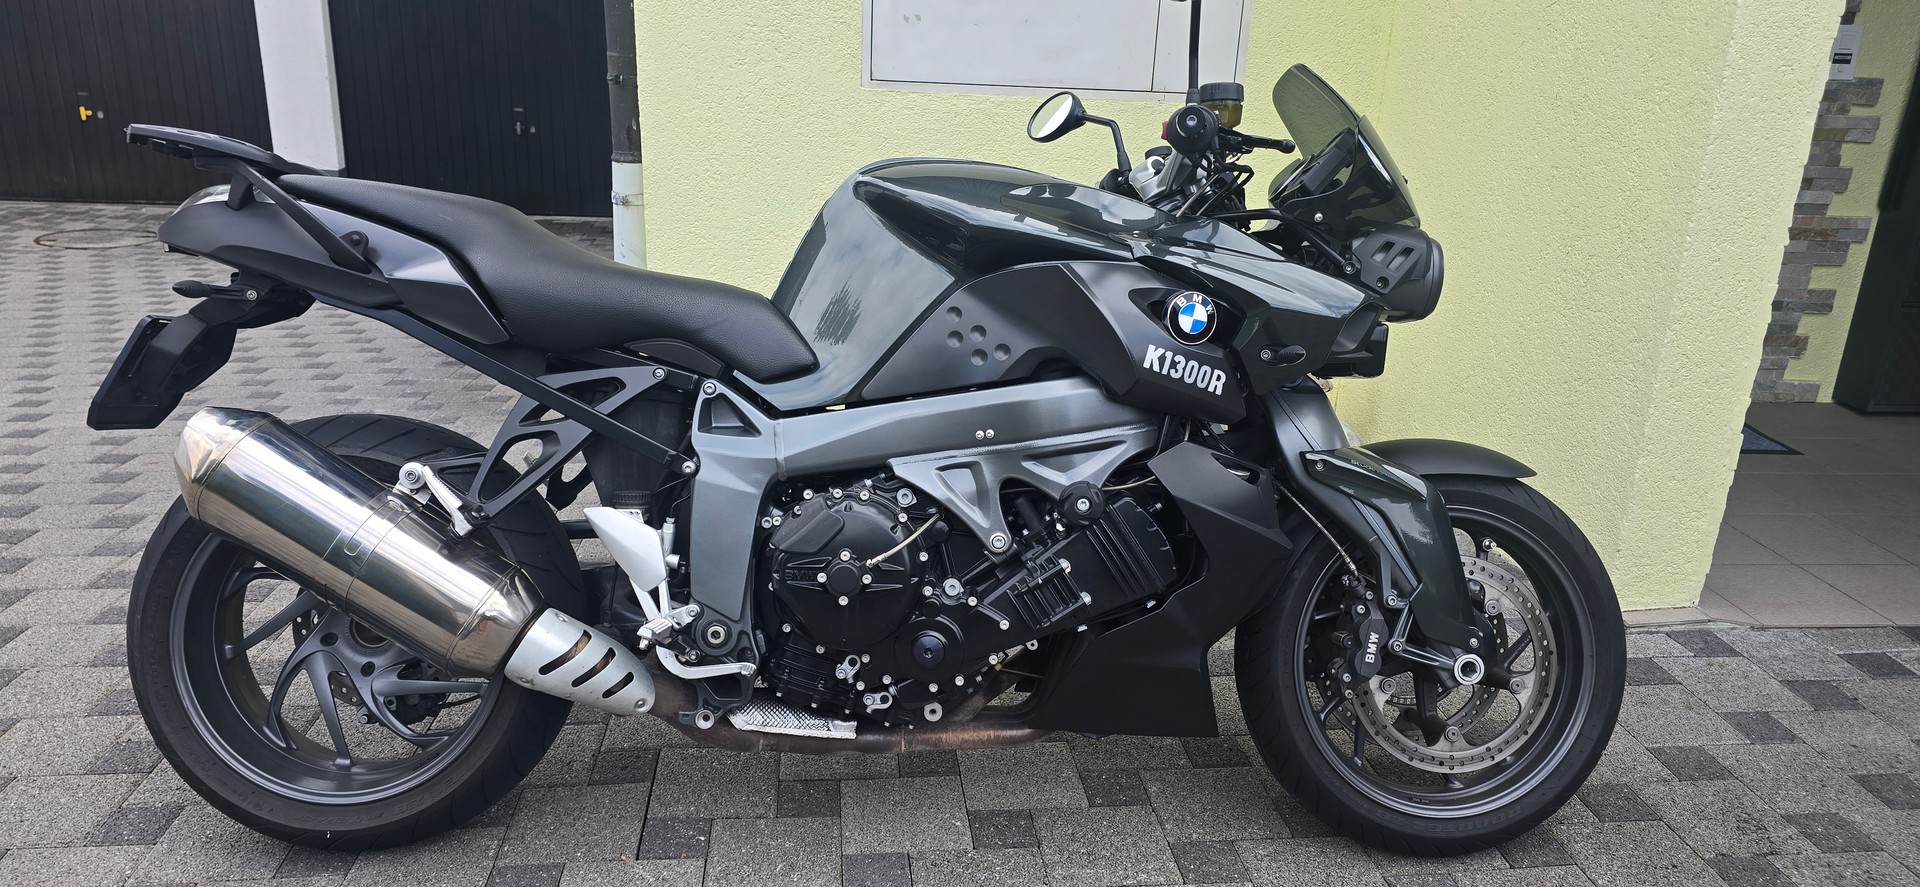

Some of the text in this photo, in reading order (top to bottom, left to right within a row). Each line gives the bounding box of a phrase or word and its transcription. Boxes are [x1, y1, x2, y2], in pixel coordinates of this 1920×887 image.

[1176, 293, 1214, 315] BMW
[1143, 344, 1227, 396] K1300R
[785, 569, 819, 580] BMW
[1364, 631, 1380, 664] BMW
